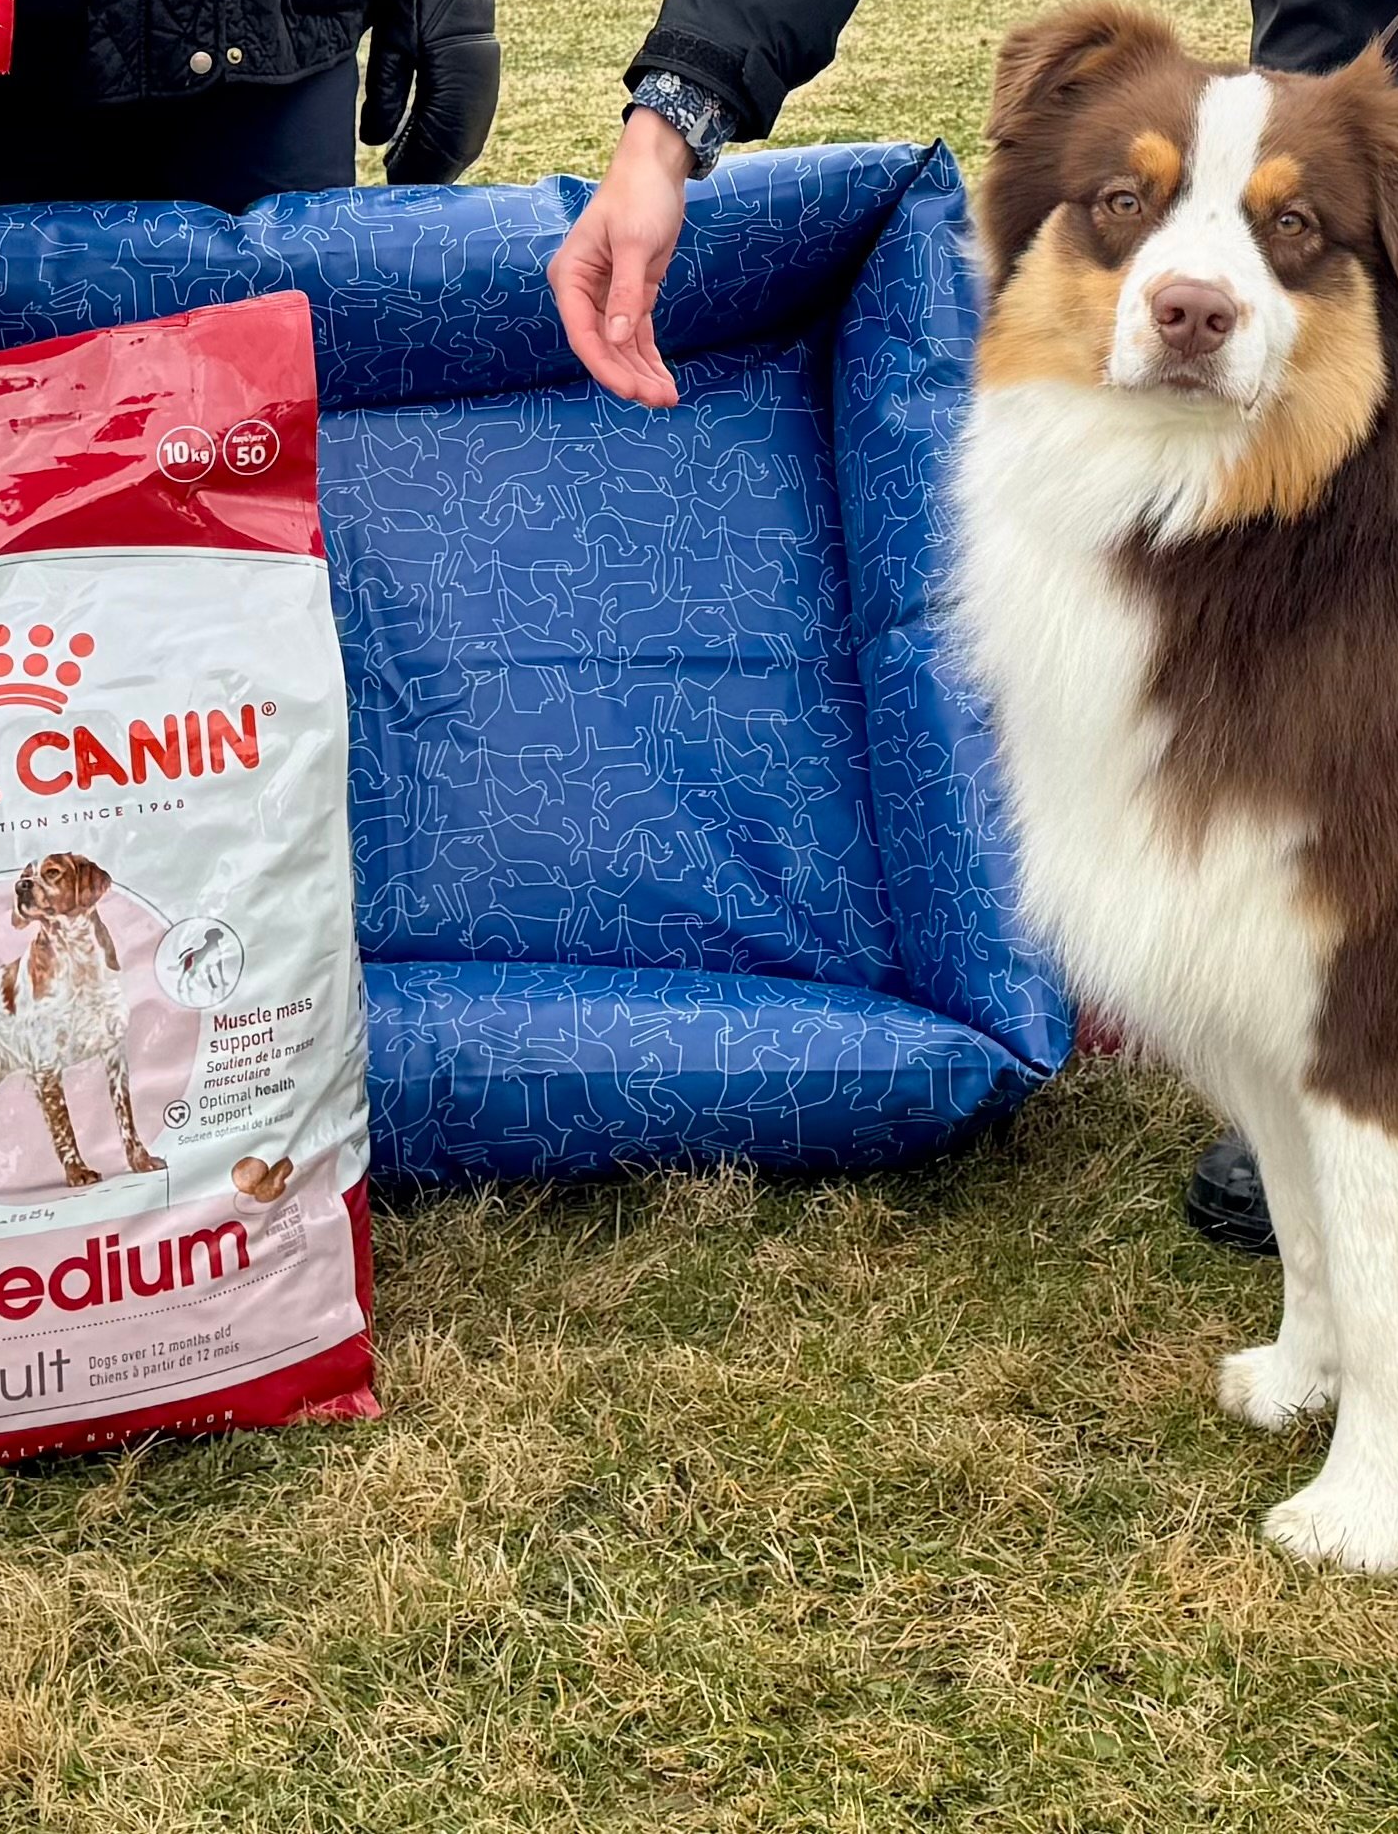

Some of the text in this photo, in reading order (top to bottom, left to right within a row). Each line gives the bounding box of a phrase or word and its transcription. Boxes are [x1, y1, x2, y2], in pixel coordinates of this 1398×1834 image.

[235, 446, 266, 466] 50
[16, 702, 261, 796] CANIN
[61, 806, 125, 825] SINCE
[137, 799, 186, 815] 1968
[213, 997, 313, 1032] Muscle mass
[209, 1027, 274, 1054] support
[206, 1055, 252, 1073] Soutien
[255, 1050, 268, 1063] de
[271, 1047, 282, 1059] la
[204, 1067, 271, 1089] musculaire
[199, 1077, 295, 1110] Optimal health
[200, 1105, 253, 1126] support
[177, 1130, 213, 1146] Soutien
[88, 1323, 233, 1370] Dogs over 12 months old
[89, 1341, 241, 1387] Chiens à partir de 12 mois
[87, 1410, 234, 1444] NUTTION
